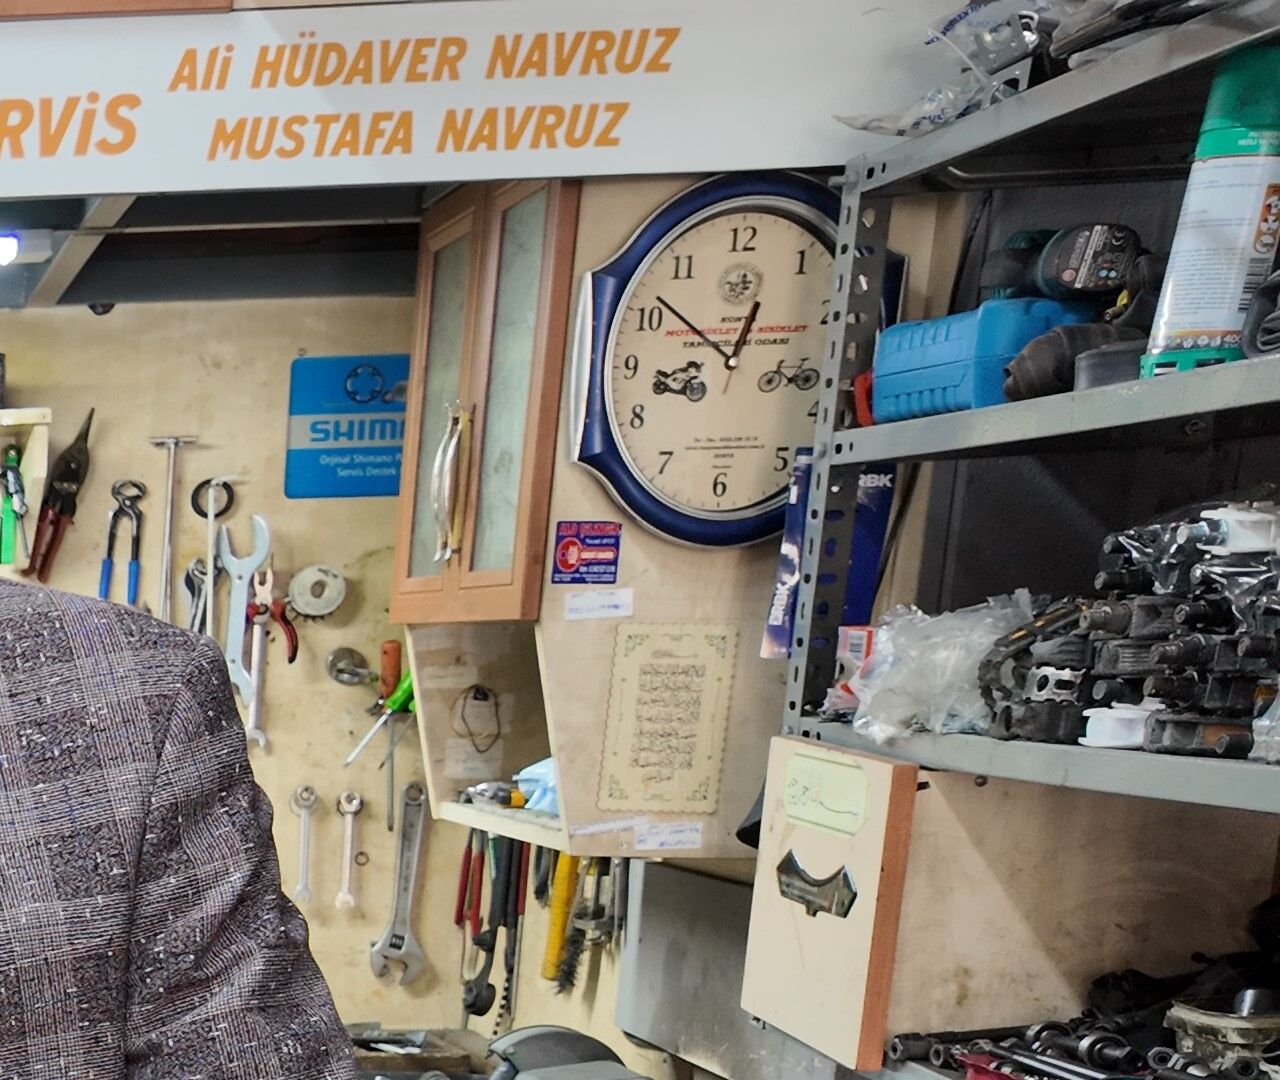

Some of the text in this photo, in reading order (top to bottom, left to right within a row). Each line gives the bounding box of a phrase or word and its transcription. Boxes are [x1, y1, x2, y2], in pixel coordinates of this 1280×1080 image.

[168, 27, 682, 92] Ali HÜDAVER NAVRUZ
[207, 101, 630, 163] MUSTAFA NAVRUZ
[729, 226, 756, 252] 12
[671, 255, 693, 280] 11
[794, 250, 807, 275] 1
[636, 306, 663, 332] 10
[624, 355, 638, 379] 9
[629, 405, 645, 429] 8
[309, 418, 406, 442] SHIM
[658, 451, 674, 475] 7
[773, 447, 789, 471] 5
[712, 472, 727, 497] 6
